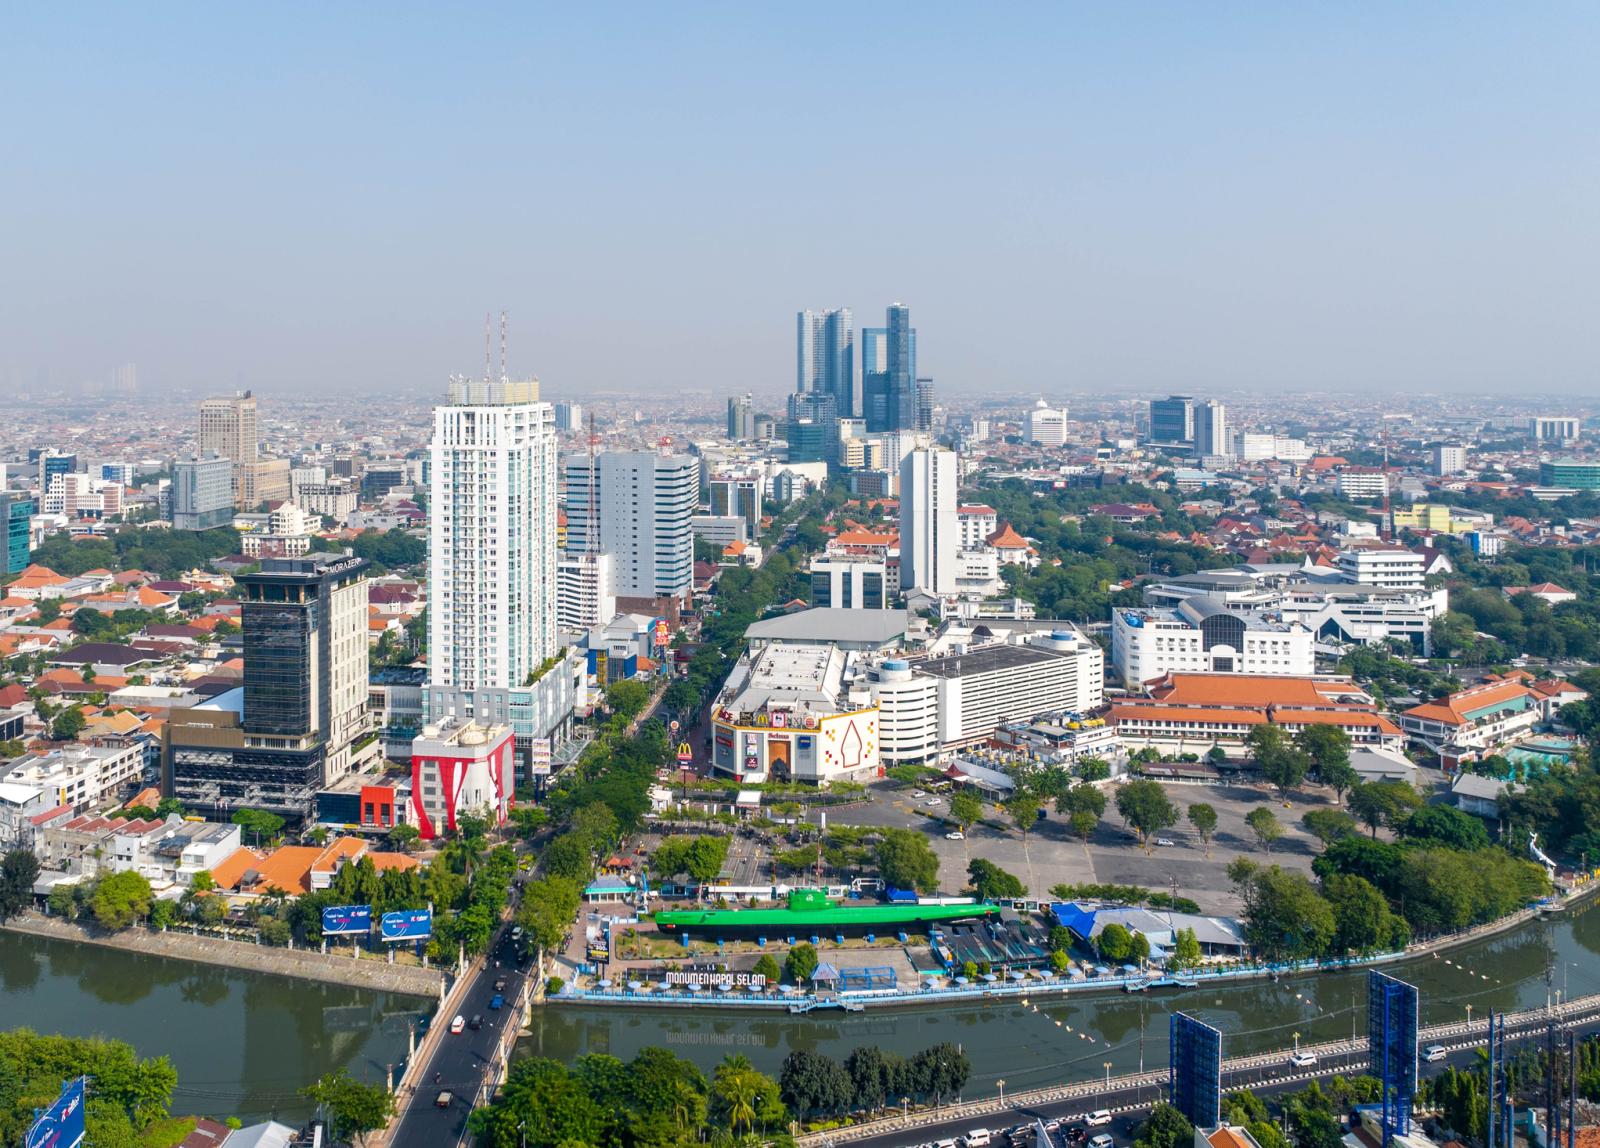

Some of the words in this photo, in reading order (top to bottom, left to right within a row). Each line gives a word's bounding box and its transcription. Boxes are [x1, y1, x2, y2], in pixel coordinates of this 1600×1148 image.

[665, 972, 709, 985] MONUMEN
[710, 972, 736, 985] KAPAL
[736, 973, 766, 986] SELAM
